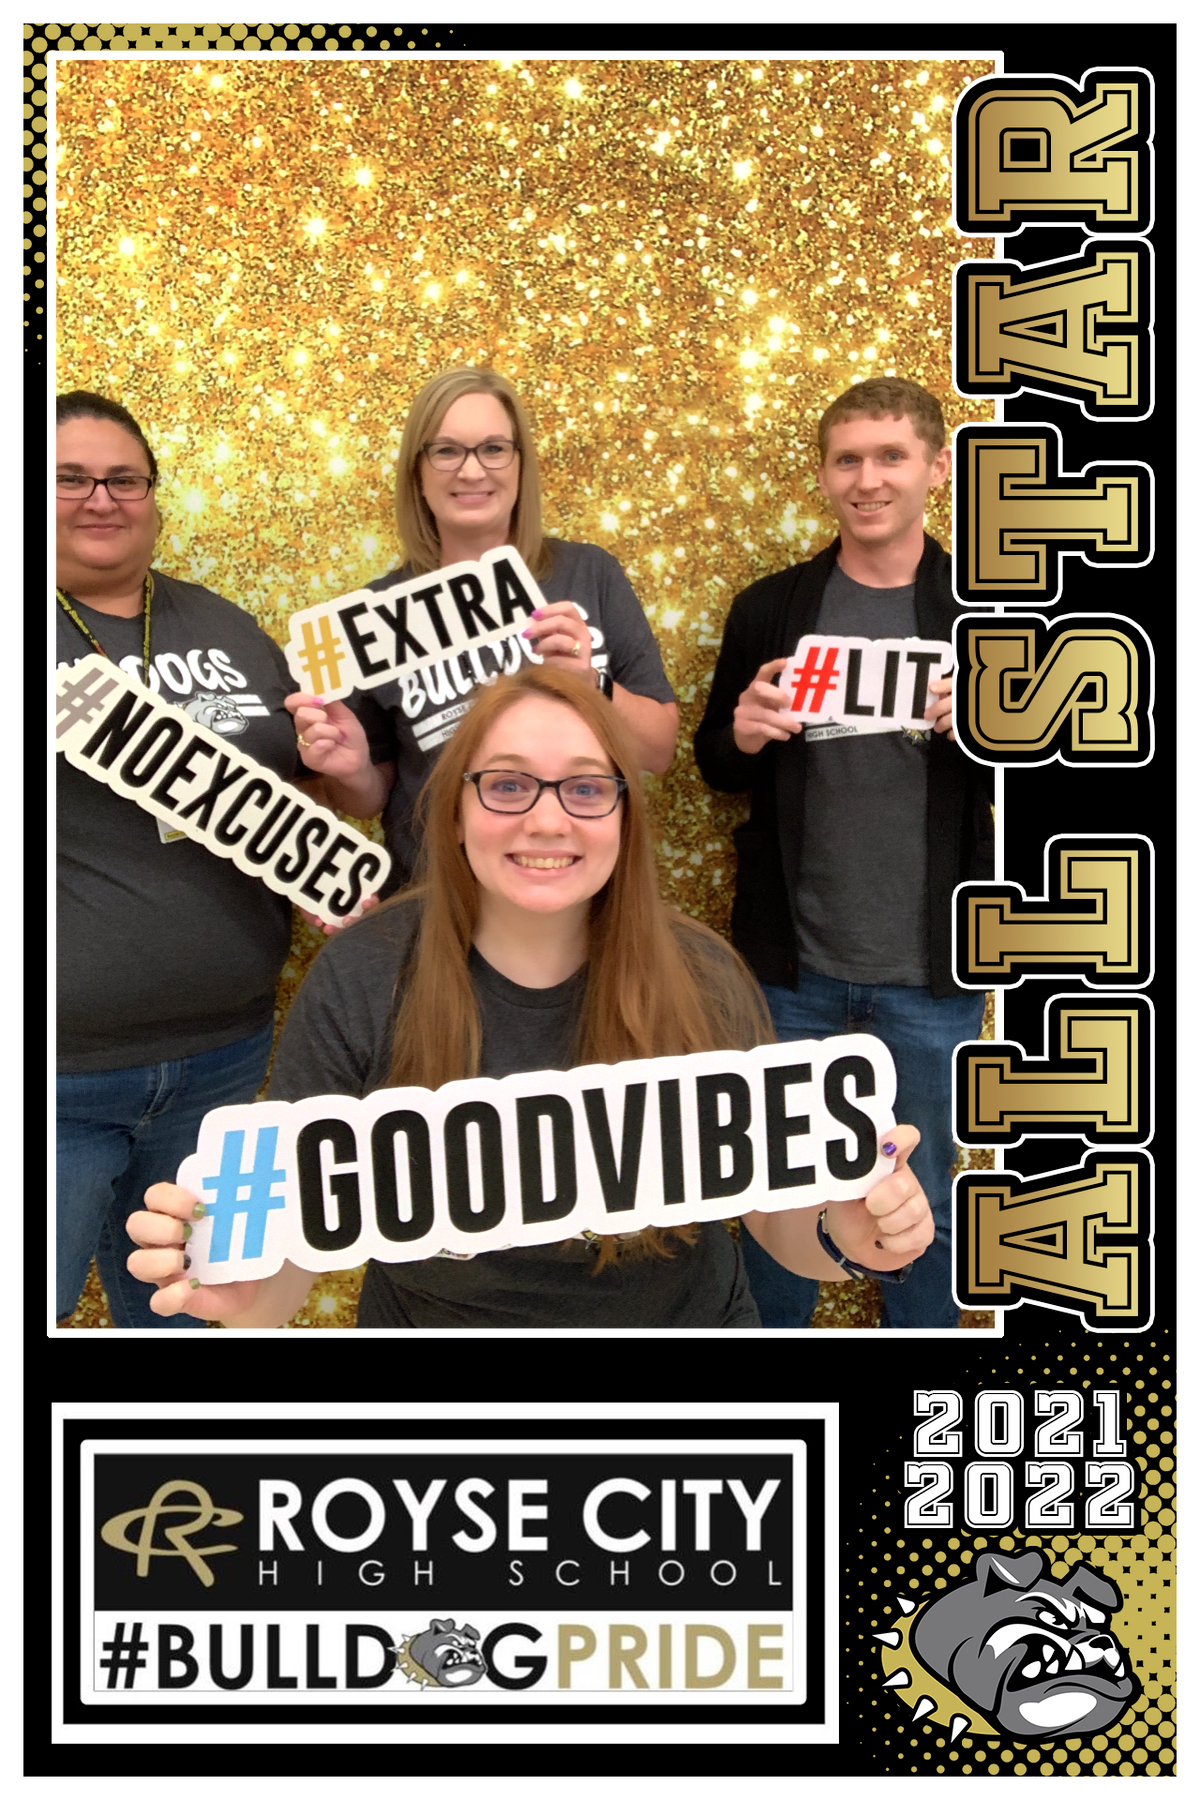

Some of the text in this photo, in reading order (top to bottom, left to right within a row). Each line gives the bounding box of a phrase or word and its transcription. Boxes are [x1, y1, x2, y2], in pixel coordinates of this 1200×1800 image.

[298, 558, 536, 695] #EXTRA
[790, 646, 943, 719] #LIT
[56, 667, 382, 917] #NOEXCUSES
[826, 725, 858, 736] SCHOOL
[202, 1056, 877, 1263] #GOODVIBES
